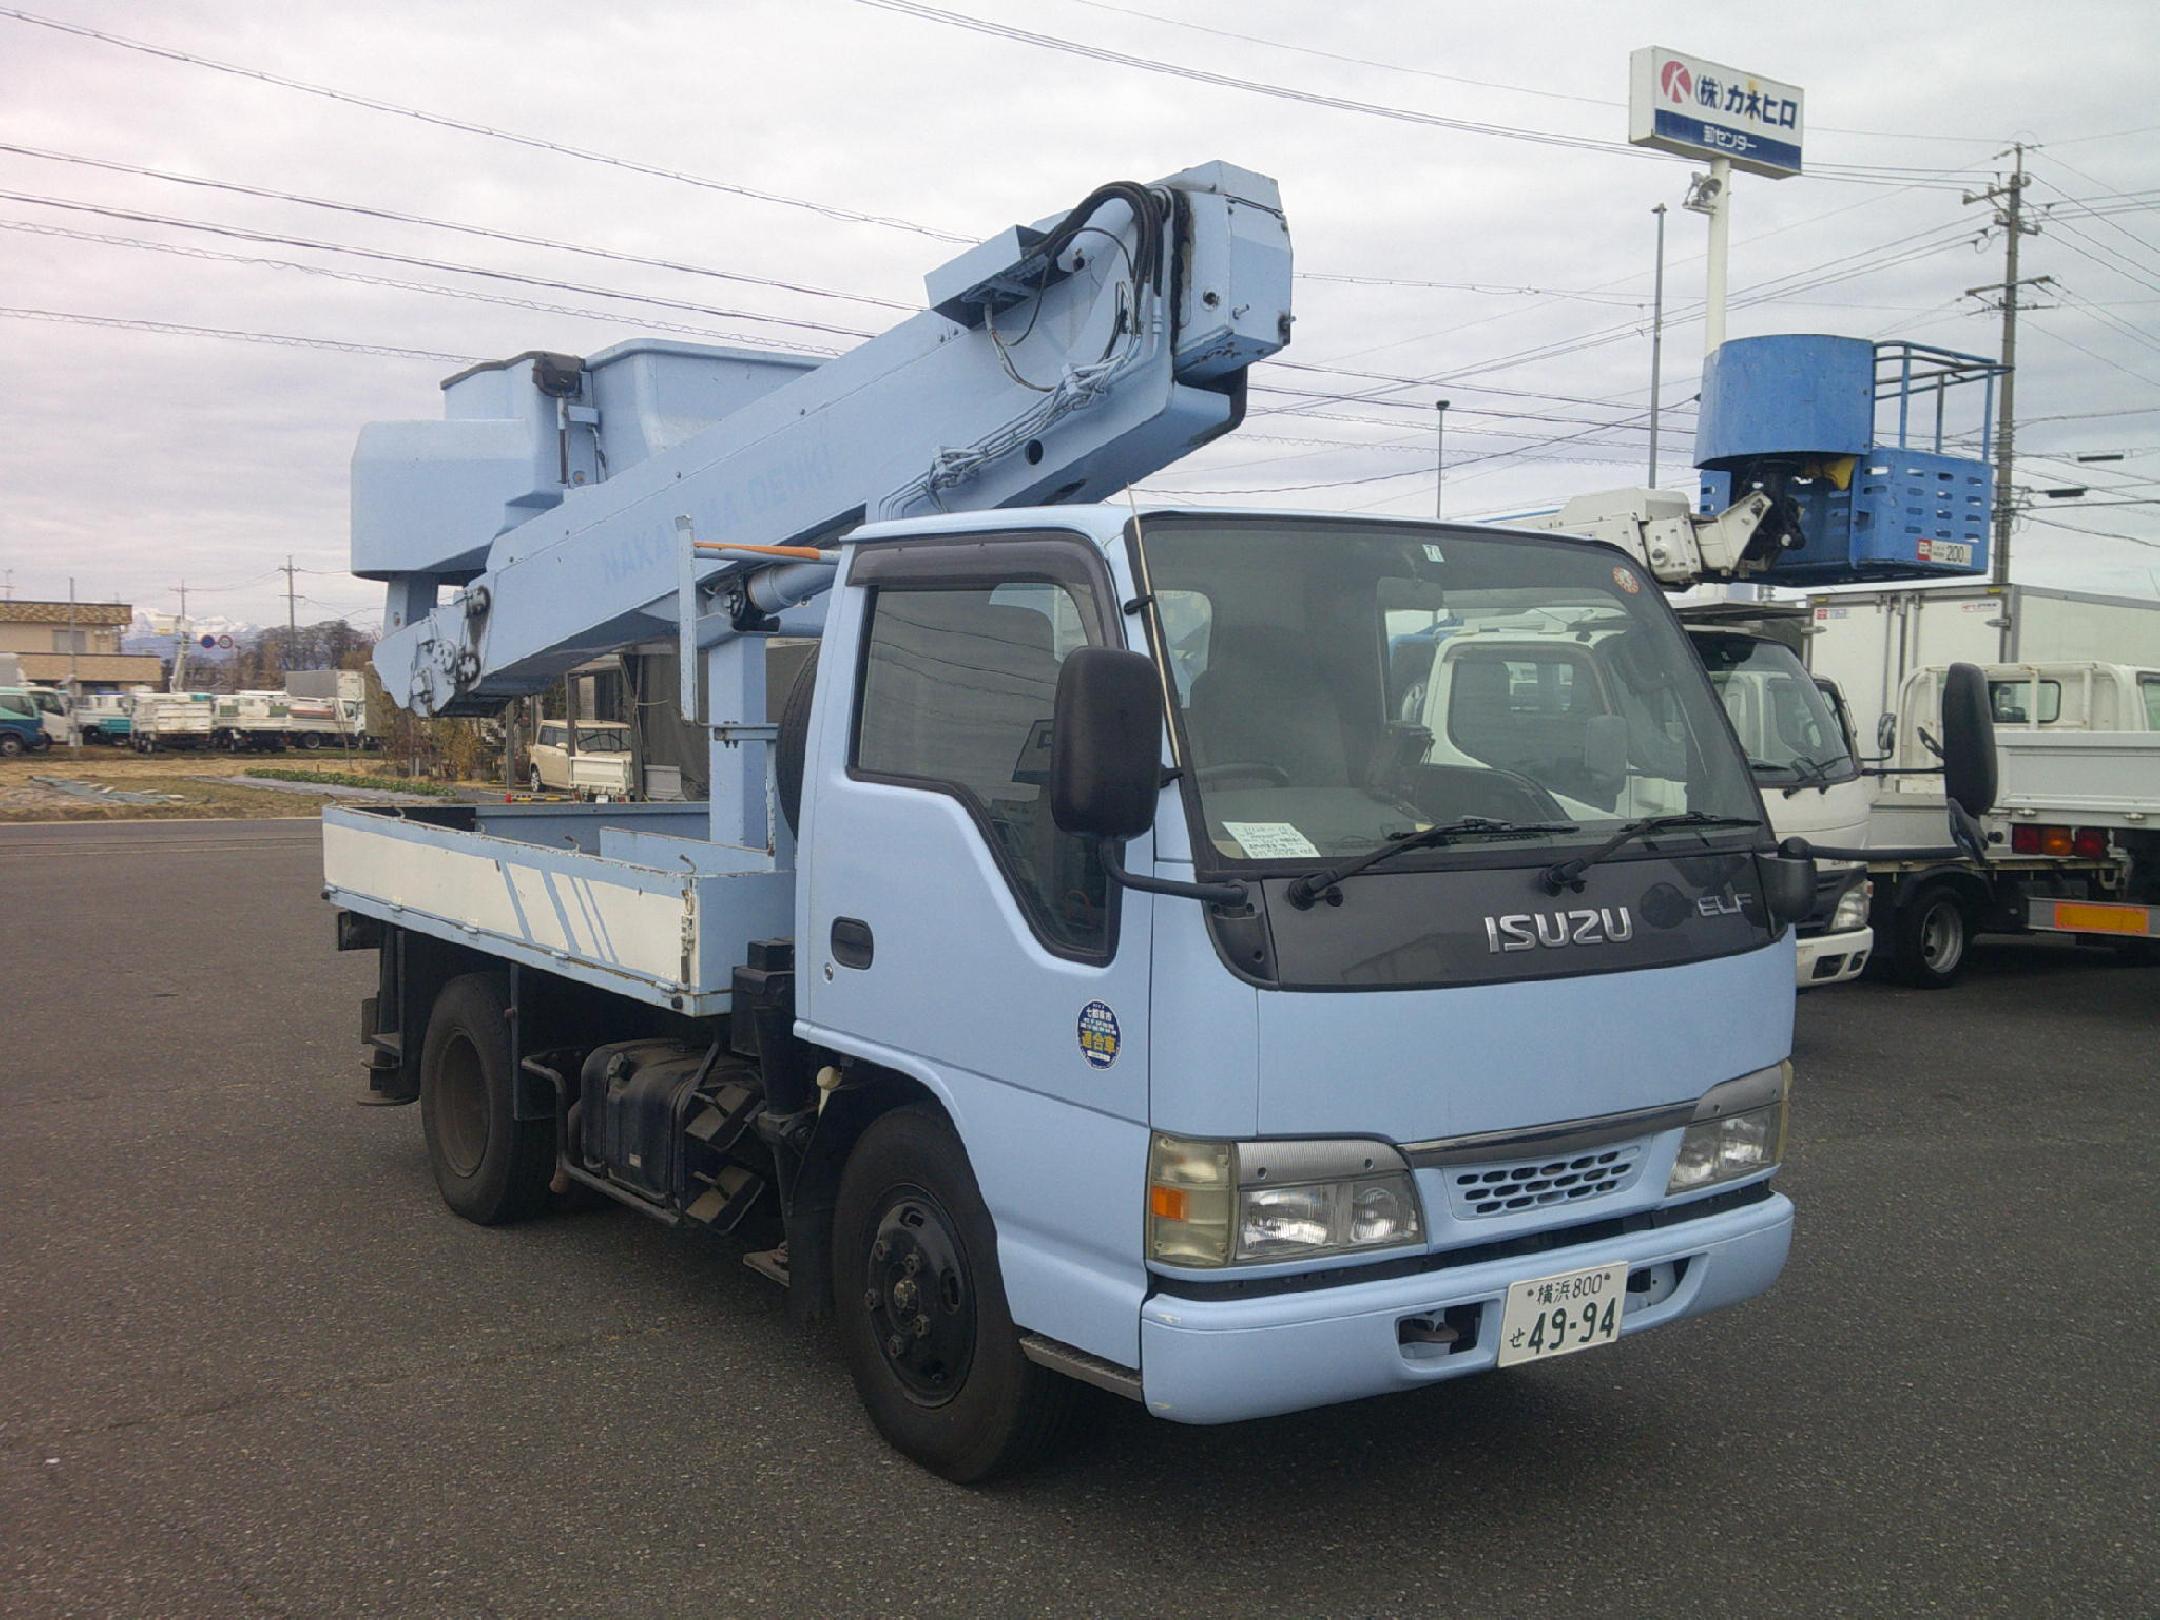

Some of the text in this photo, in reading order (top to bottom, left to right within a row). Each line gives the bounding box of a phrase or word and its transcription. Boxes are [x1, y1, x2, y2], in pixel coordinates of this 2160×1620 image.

[1697, 893, 1752, 918] ELF
[1484, 906, 1634, 953] ISUZU
[1509, 1297, 1617, 1355] せ 49-94
